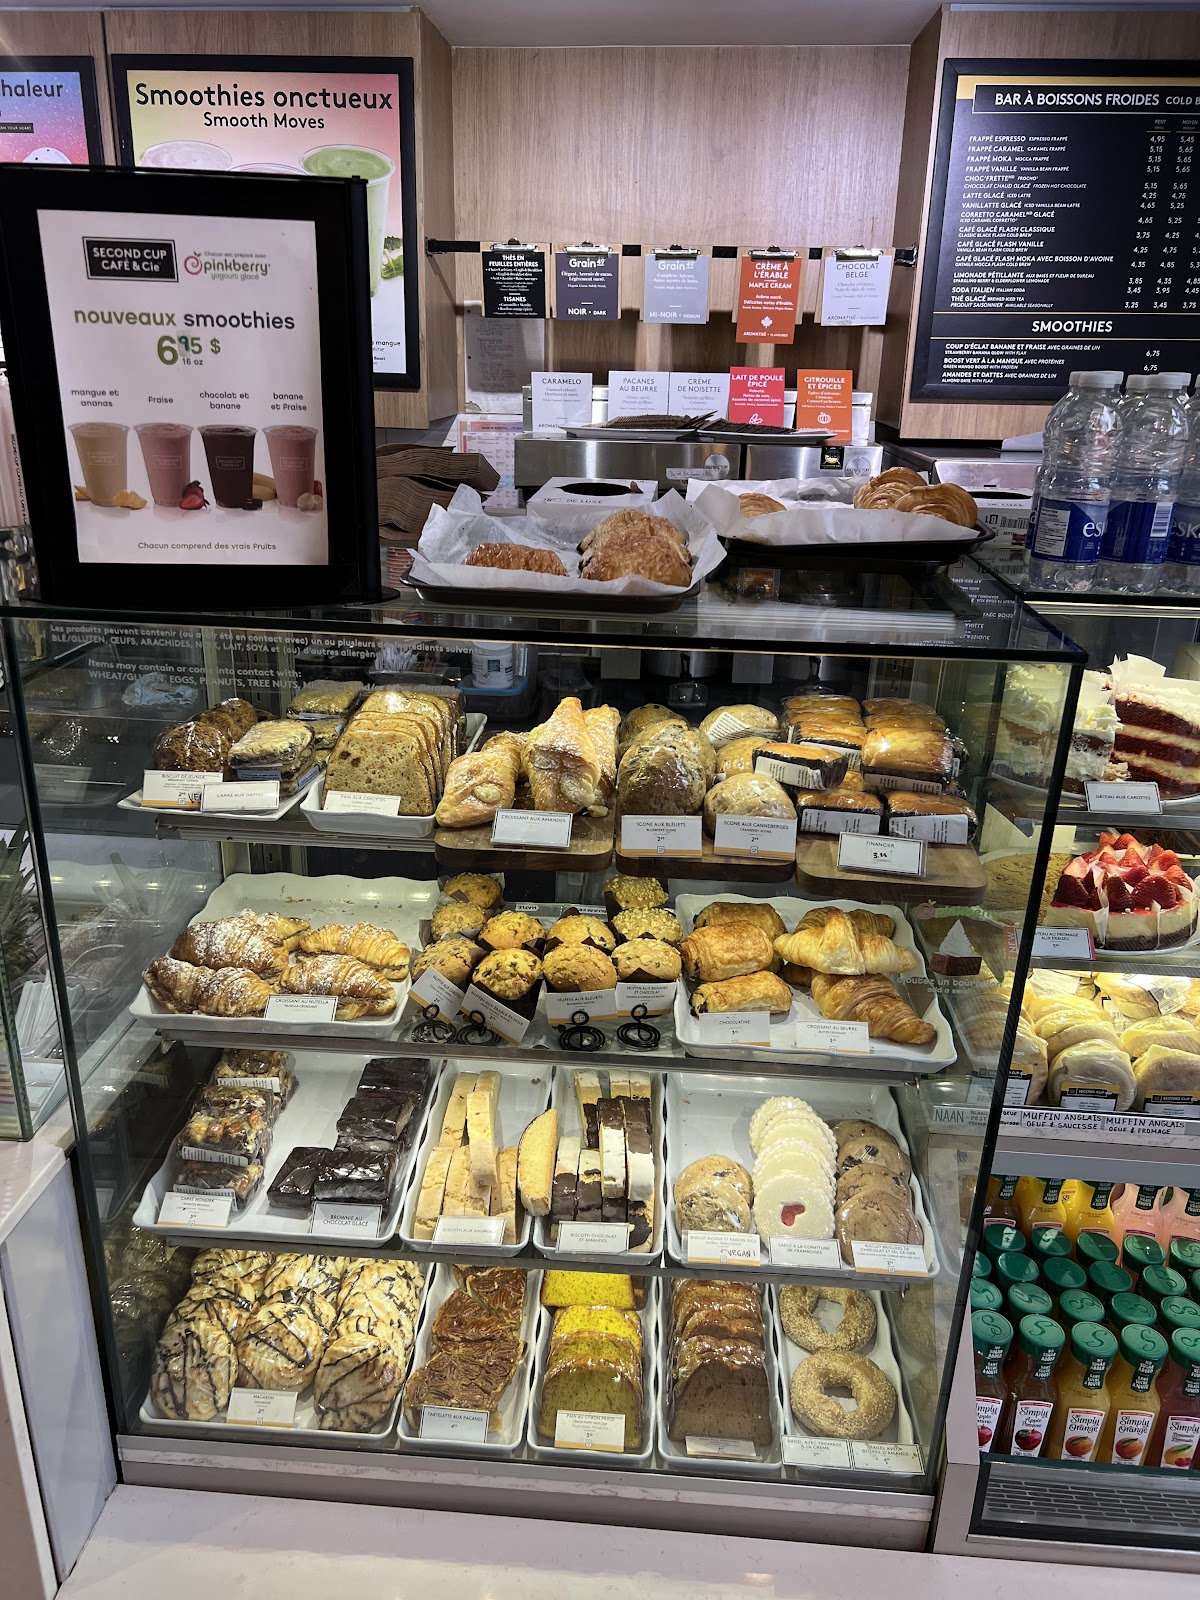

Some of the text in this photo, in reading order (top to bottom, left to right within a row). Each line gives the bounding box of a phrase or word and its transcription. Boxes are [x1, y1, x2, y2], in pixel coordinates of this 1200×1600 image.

[0, 79, 63, 97] haleur
[135, 83, 393, 110] Smoothies onctueux
[995, 90, 1192, 106] BAR À BOISSONS FROIDES COLD
[203, 112, 325, 130] Smooth Moves
[969, 134, 993, 142] FRAPPÉ
[1150, 136, 1195, 144] 4,95 5,45
[968, 144, 992, 152] FRAPPÉ
[983, 191, 1004, 199] GLACÉ
[92, 248, 167, 260] SECOND CUP
[973, 254, 994, 262] GLACÉ
[101, 258, 160, 271] CAFÉ & Cie
[204, 258, 268, 276] pinkberry
[569, 258, 596, 267] Grain
[658, 261, 685, 270] Grain
[755, 261, 788, 271] CRÈME À
[836, 263, 879, 271] CHOCOLAT
[241, 273, 259, 281] glacé
[754, 270, 788, 279] L'ÉRABLE
[988, 271, 1024, 279] PÉTILLANTE
[74, 310, 295, 329] nouveaux smoothies
[1032, 320, 1113, 333] SMOOTHIES
[210, 337, 221, 355] $
[965, 342, 988, 350] D'ÉCLAT
[71, 389, 107, 397] mangue
[210, 402, 241, 410] banane
[138, 542, 169, 550] Chacun
[171, 542, 212, 551] comprend
[214, 542, 229, 550] des
[51, 624, 64, 633] Les
[105, 628, 138, 636] peuvent
[141, 629, 176, 637] contenir
[110, 636, 244, 652] ŒUFS, ARACHIDES, LAIT,
[89, 658, 114, 668] Items
[116, 662, 136, 672] may
[139, 663, 174, 672] contain
[237, 668, 274, 677] contact
[170, 676, 270, 688] EGGS, TREE
[501, 814, 528, 822] CROISSANT
[934, 1108, 964, 1123] NAAN
[1023, 1111, 1102, 1122] MUFFIN ANGLAIS
[1058, 1122, 1098, 1130] SAUCISSE
[1106, 1117, 1185, 1129] MUFFIN ANGLAIS
[1137, 1127, 1171, 1135] FROMAGE
[1019, 1407, 1048, 1419] Simply
[1070, 1415, 1100, 1427] Simply
[1069, 1424, 1098, 1433] Orange
[1170, 1422, 1200, 1433] Simply
